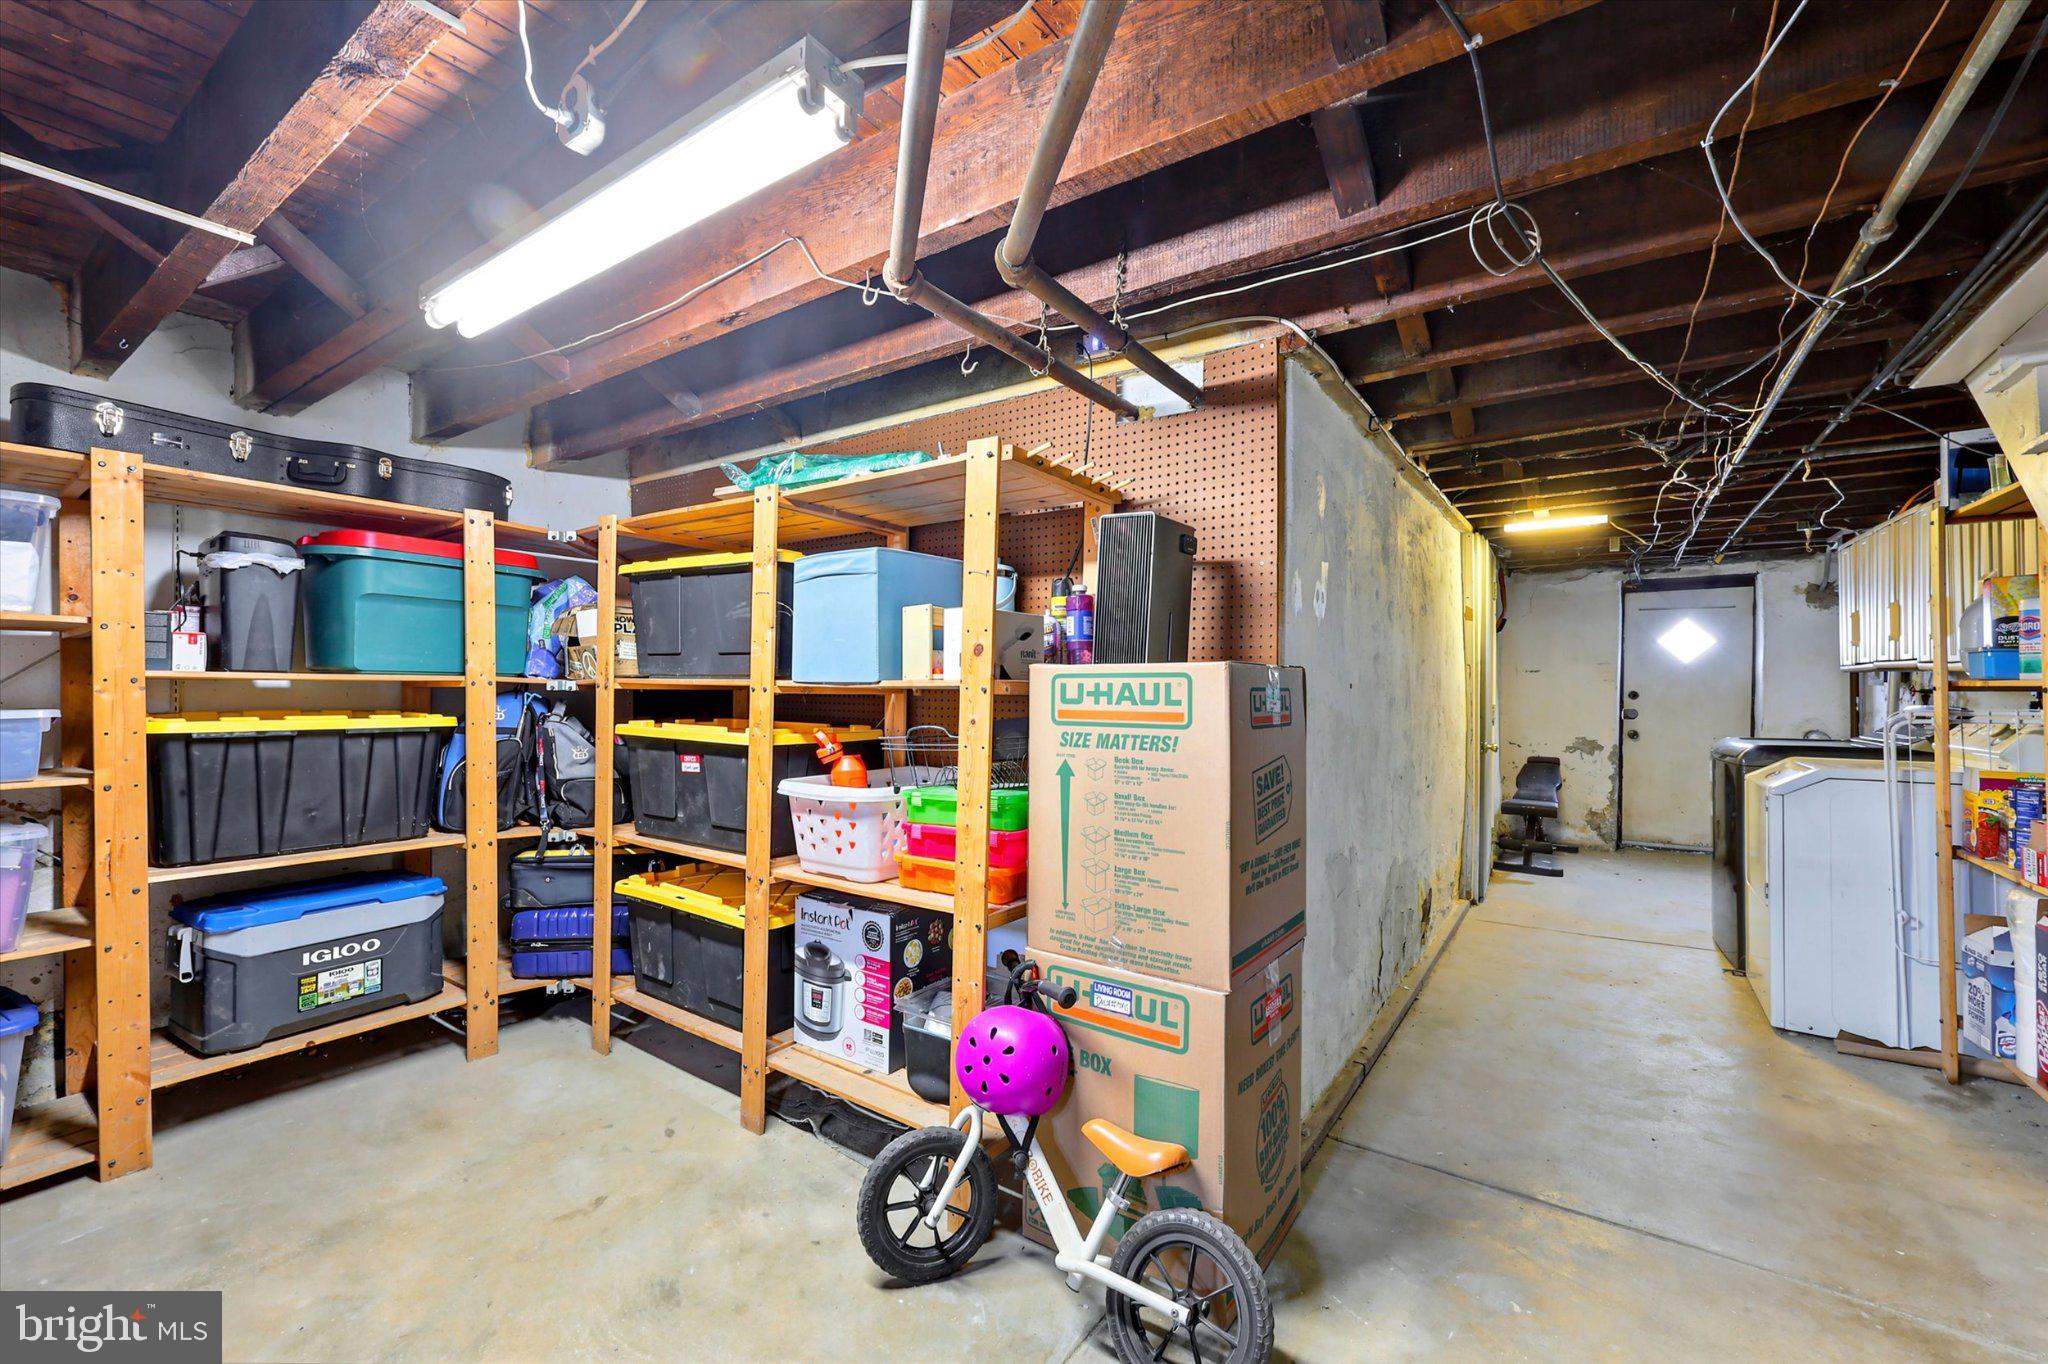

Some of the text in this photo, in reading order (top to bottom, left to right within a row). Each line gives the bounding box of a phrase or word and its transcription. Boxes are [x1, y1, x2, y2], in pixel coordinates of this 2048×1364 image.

[1060, 682, 1182, 706] U-HAUL
[1060, 732, 1179, 752] SIZE MATTERS!
[1256, 764, 1284, 797] SAVE!
[1114, 866, 1132, 874] Large
[800, 907, 832, 926] Instant
[302, 938, 380, 966] IGLOO
[329, 967, 354, 977] IGLOO
[1112, 988, 1132, 1000] ROOM
[1968, 982, 1986, 1003] 20%
[1968, 994, 1986, 1012] MORE
[1968, 1008, 1986, 1025] POWER
[1080, 1048, 1112, 1076] BOX
